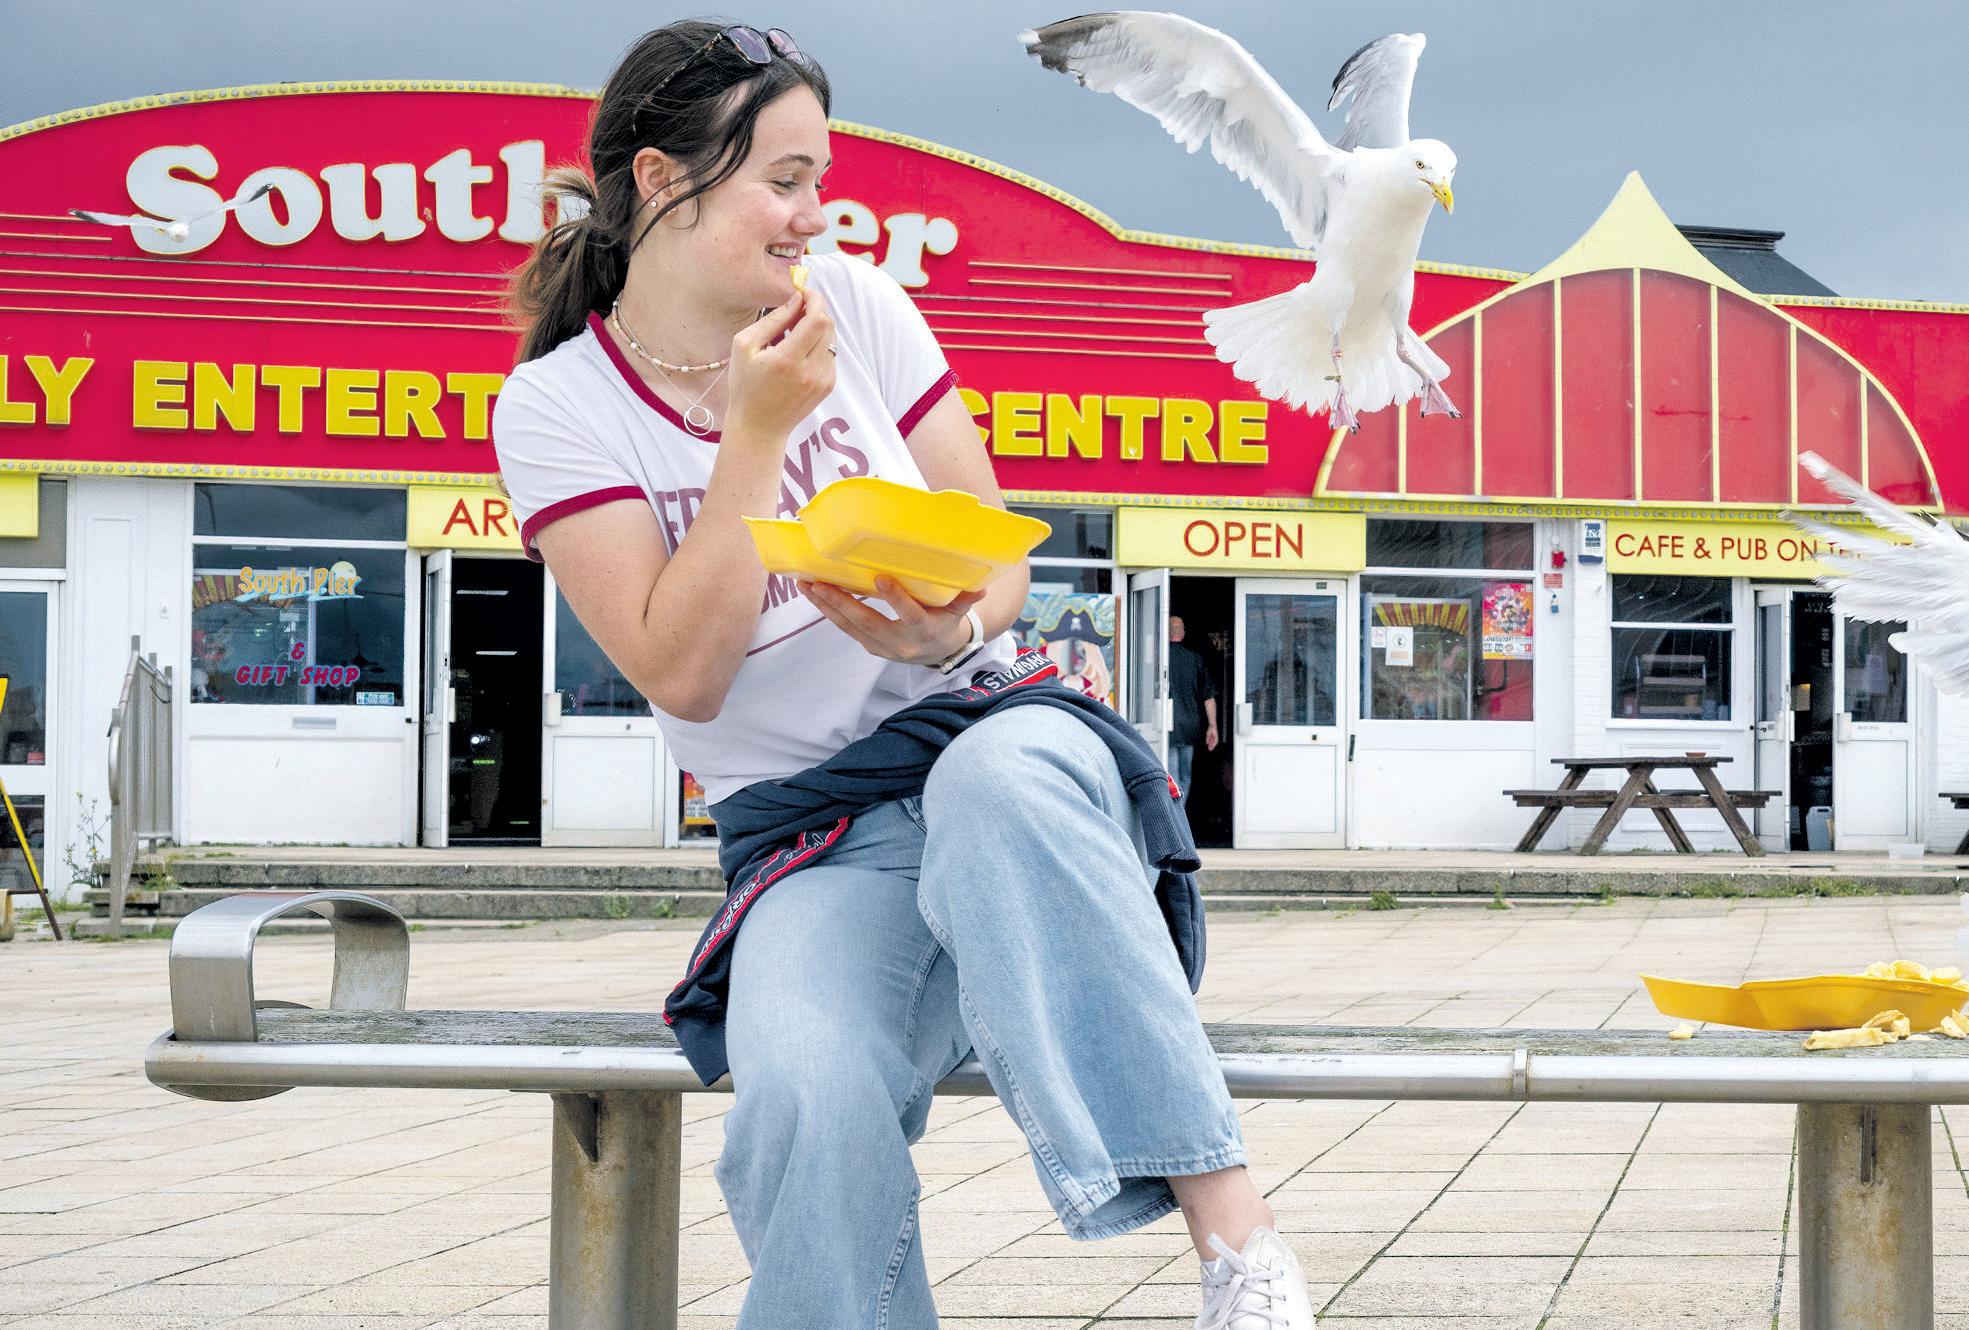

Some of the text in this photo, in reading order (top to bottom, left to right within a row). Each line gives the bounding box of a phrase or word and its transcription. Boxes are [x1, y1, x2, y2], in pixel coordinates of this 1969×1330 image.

[126, 140, 959, 288] South er
[441, 497, 519, 537] AR
[1183, 519, 1304, 560] OPEN
[1615, 533, 1684, 558] CAFE
[1693, 537, 1712, 559] &
[1721, 537, 1768, 560] PUB
[1777, 539, 1818, 562] ON
[238, 566, 362, 596] South Pier
[291, 641, 306, 661] &
[236, 665, 361, 687] GIFT SHOP
